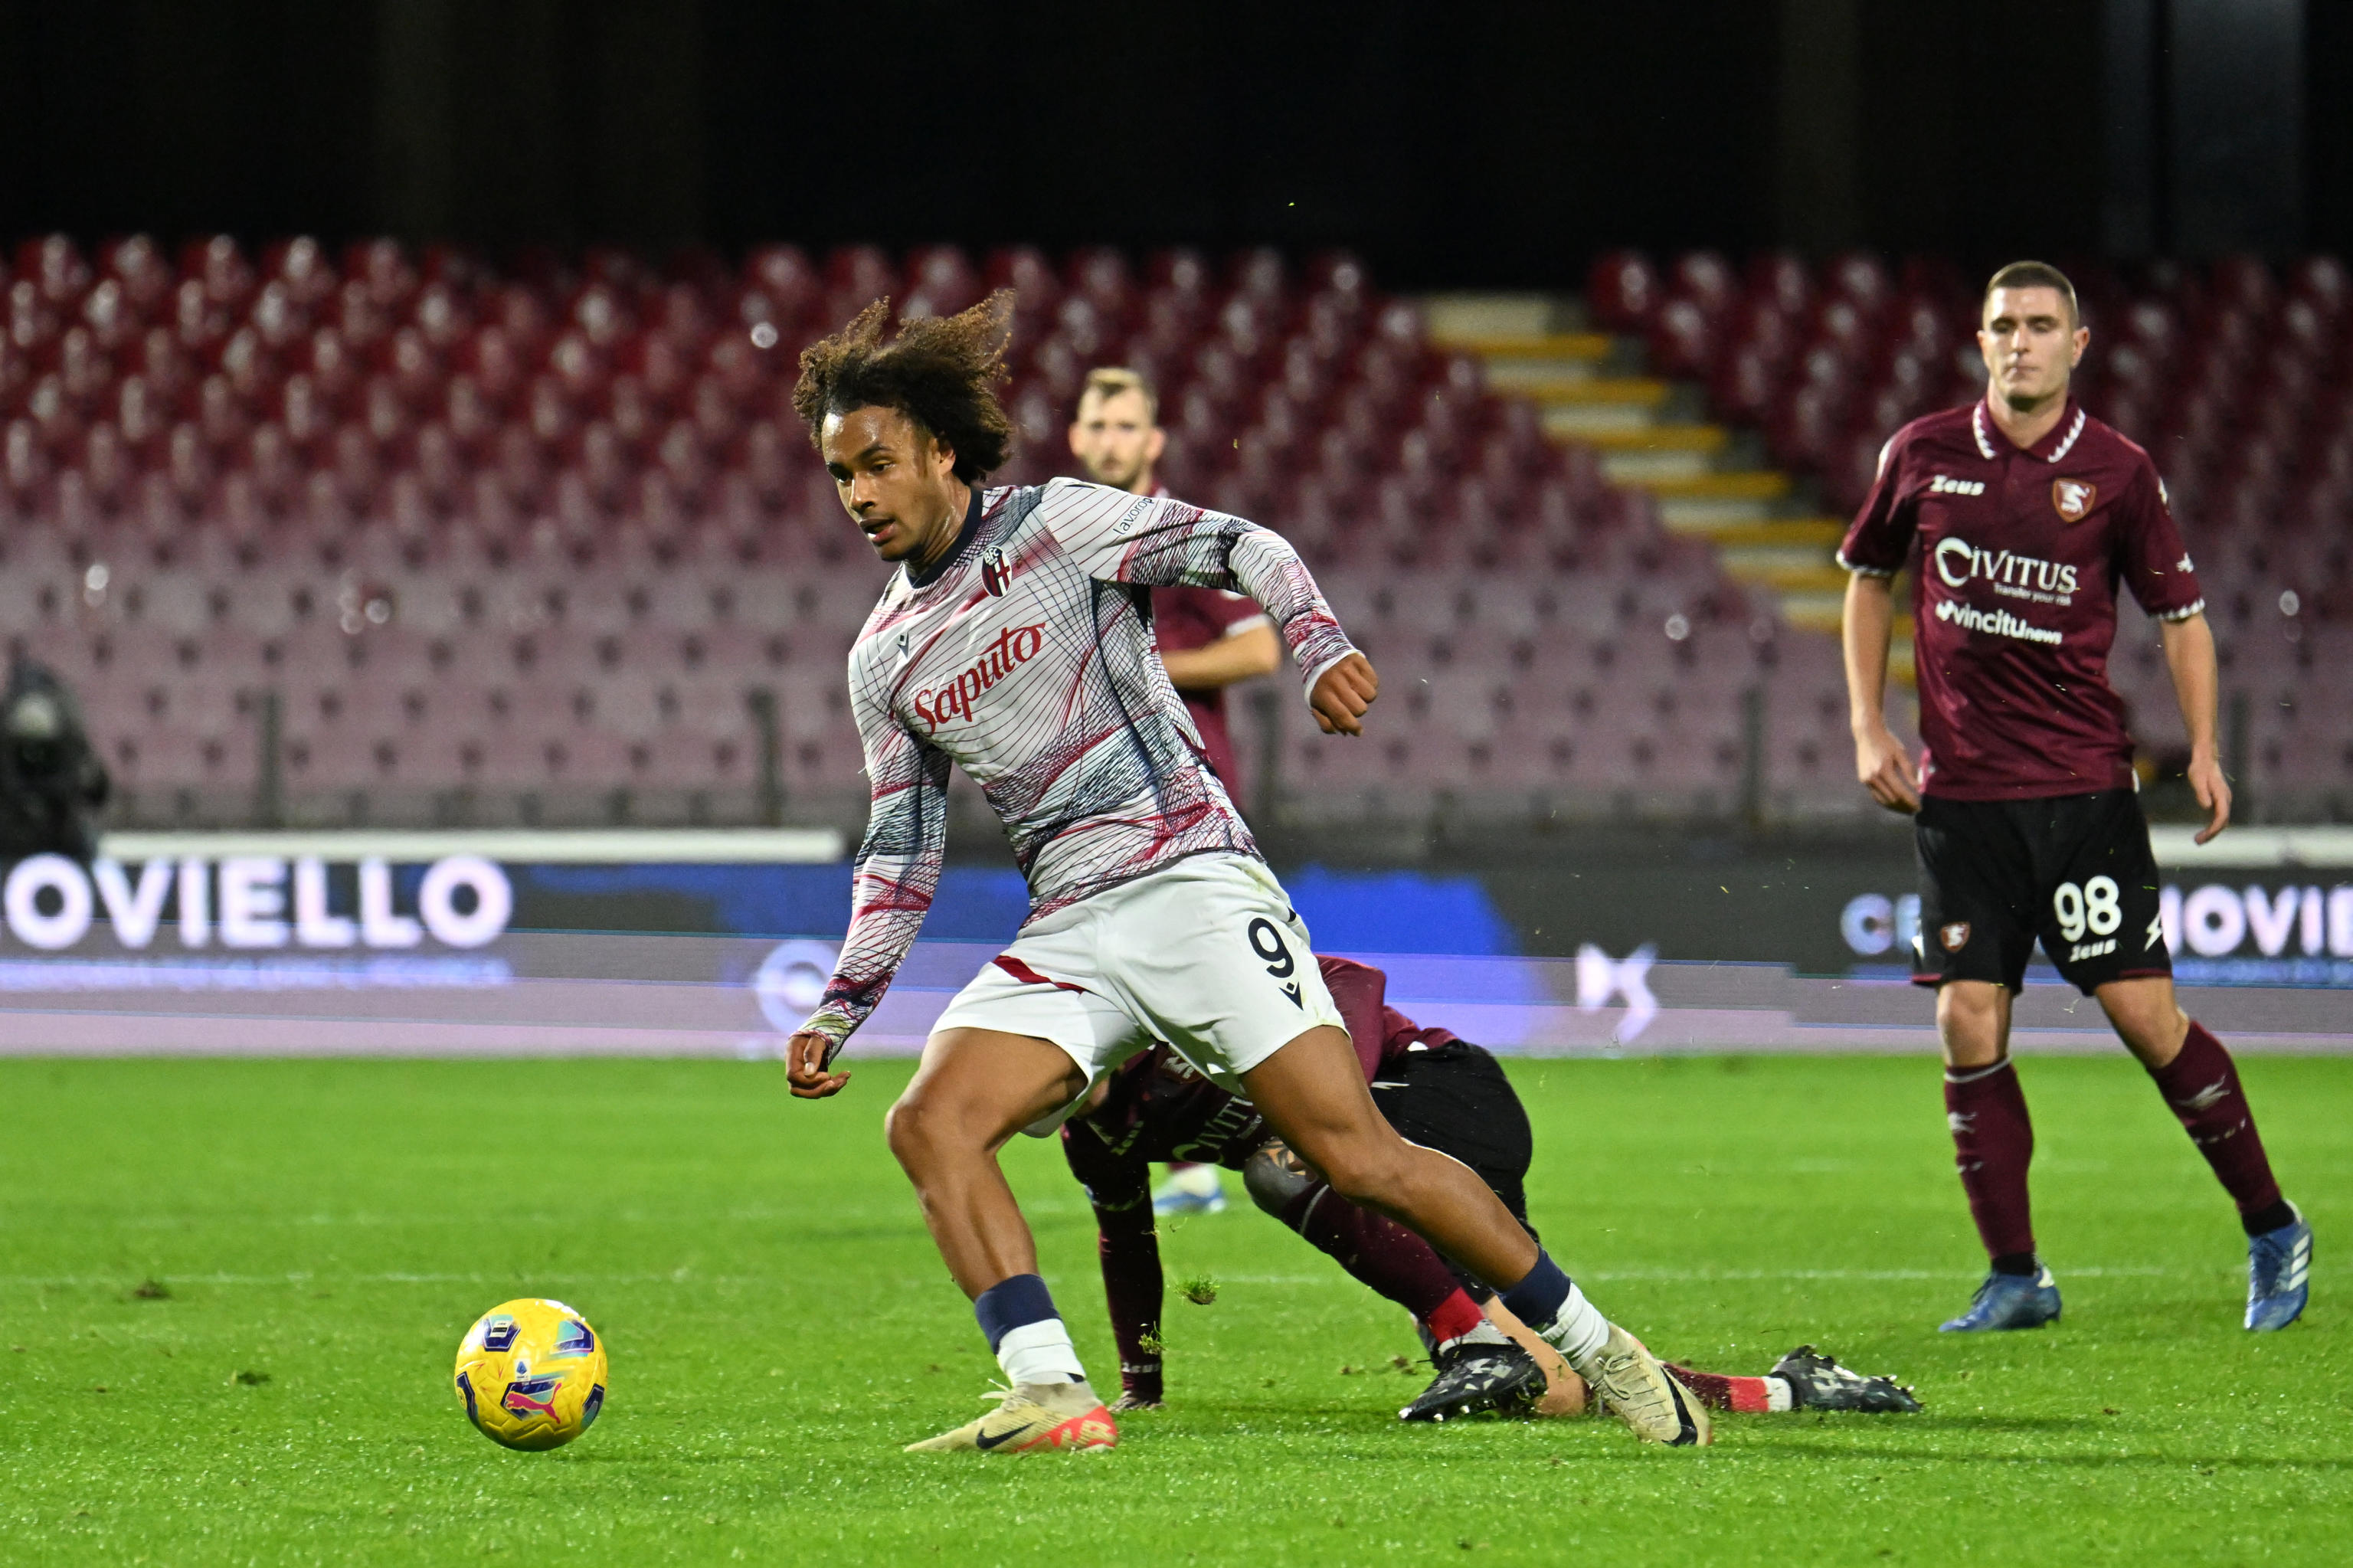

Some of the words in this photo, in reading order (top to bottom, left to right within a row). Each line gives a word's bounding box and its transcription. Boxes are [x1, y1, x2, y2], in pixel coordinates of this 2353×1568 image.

[1929, 475, 1985, 496] Zeus
[983, 547, 1000, 565] BFC
[1935, 537, 2078, 594] CIVITUS
[914, 622, 1046, 736] Saputo
[3, 852, 514, 950] OVIELLO
[2053, 876, 2122, 941] 98
[1248, 917, 1294, 979] 9
